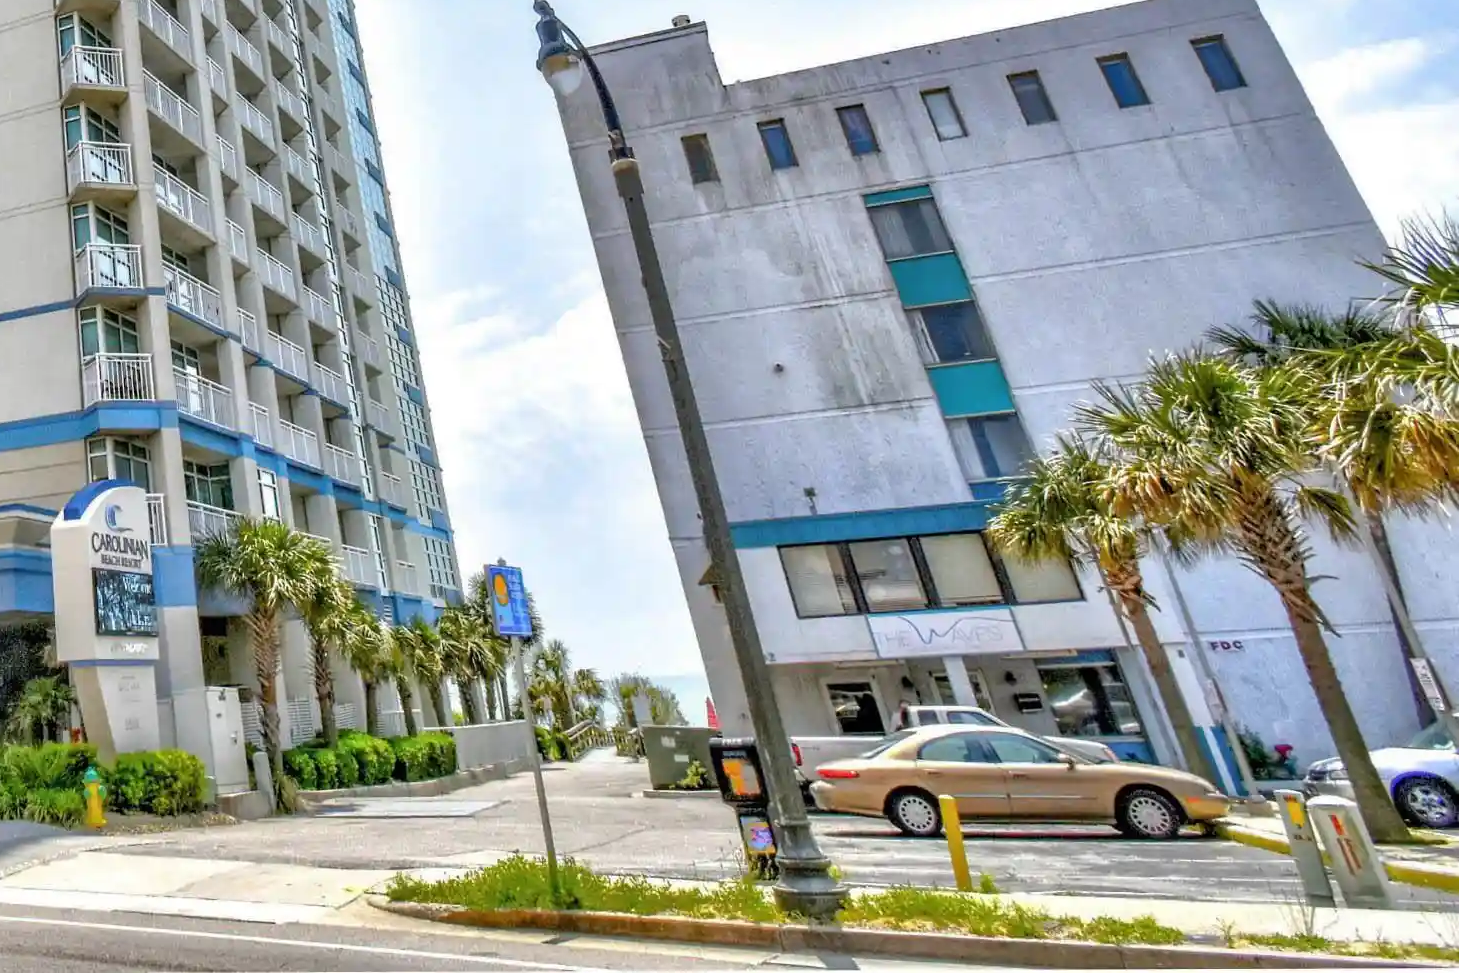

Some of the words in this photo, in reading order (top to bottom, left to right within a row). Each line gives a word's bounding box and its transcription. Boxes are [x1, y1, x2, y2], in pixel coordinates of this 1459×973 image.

[91, 532, 148, 559] CAROLINIAN
[101, 553, 120, 566] BEACH
[1210, 640, 1244, 651] FDC
